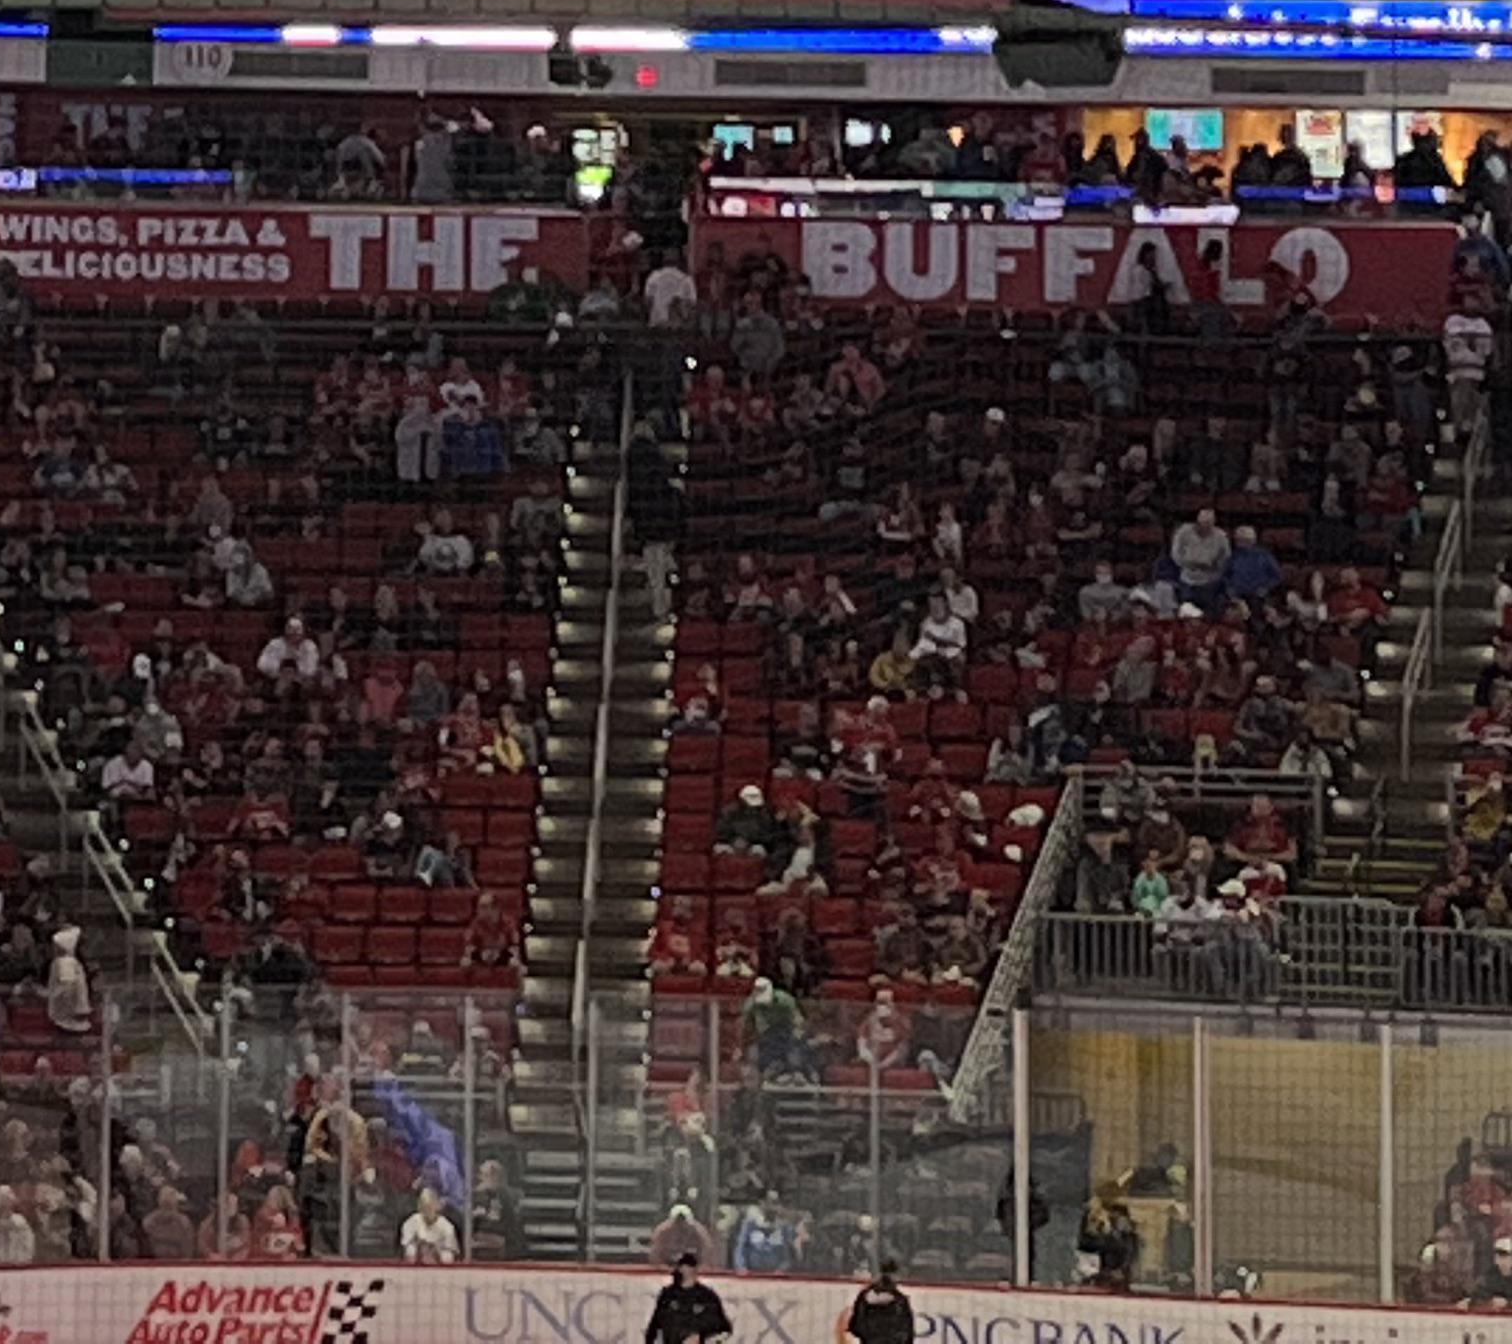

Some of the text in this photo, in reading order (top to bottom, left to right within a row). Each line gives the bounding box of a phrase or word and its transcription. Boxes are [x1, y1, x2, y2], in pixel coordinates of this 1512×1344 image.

[185, 44, 223, 69] 110
[137, 211, 249, 247] PIZZA
[255, 218, 286, 247] &
[802, 222, 1351, 309] BUFFALO
[148, 1280, 316, 1315] Advance
[125, 1316, 318, 1344] Auto Parts
[464, 1288, 626, 1343] UNC
